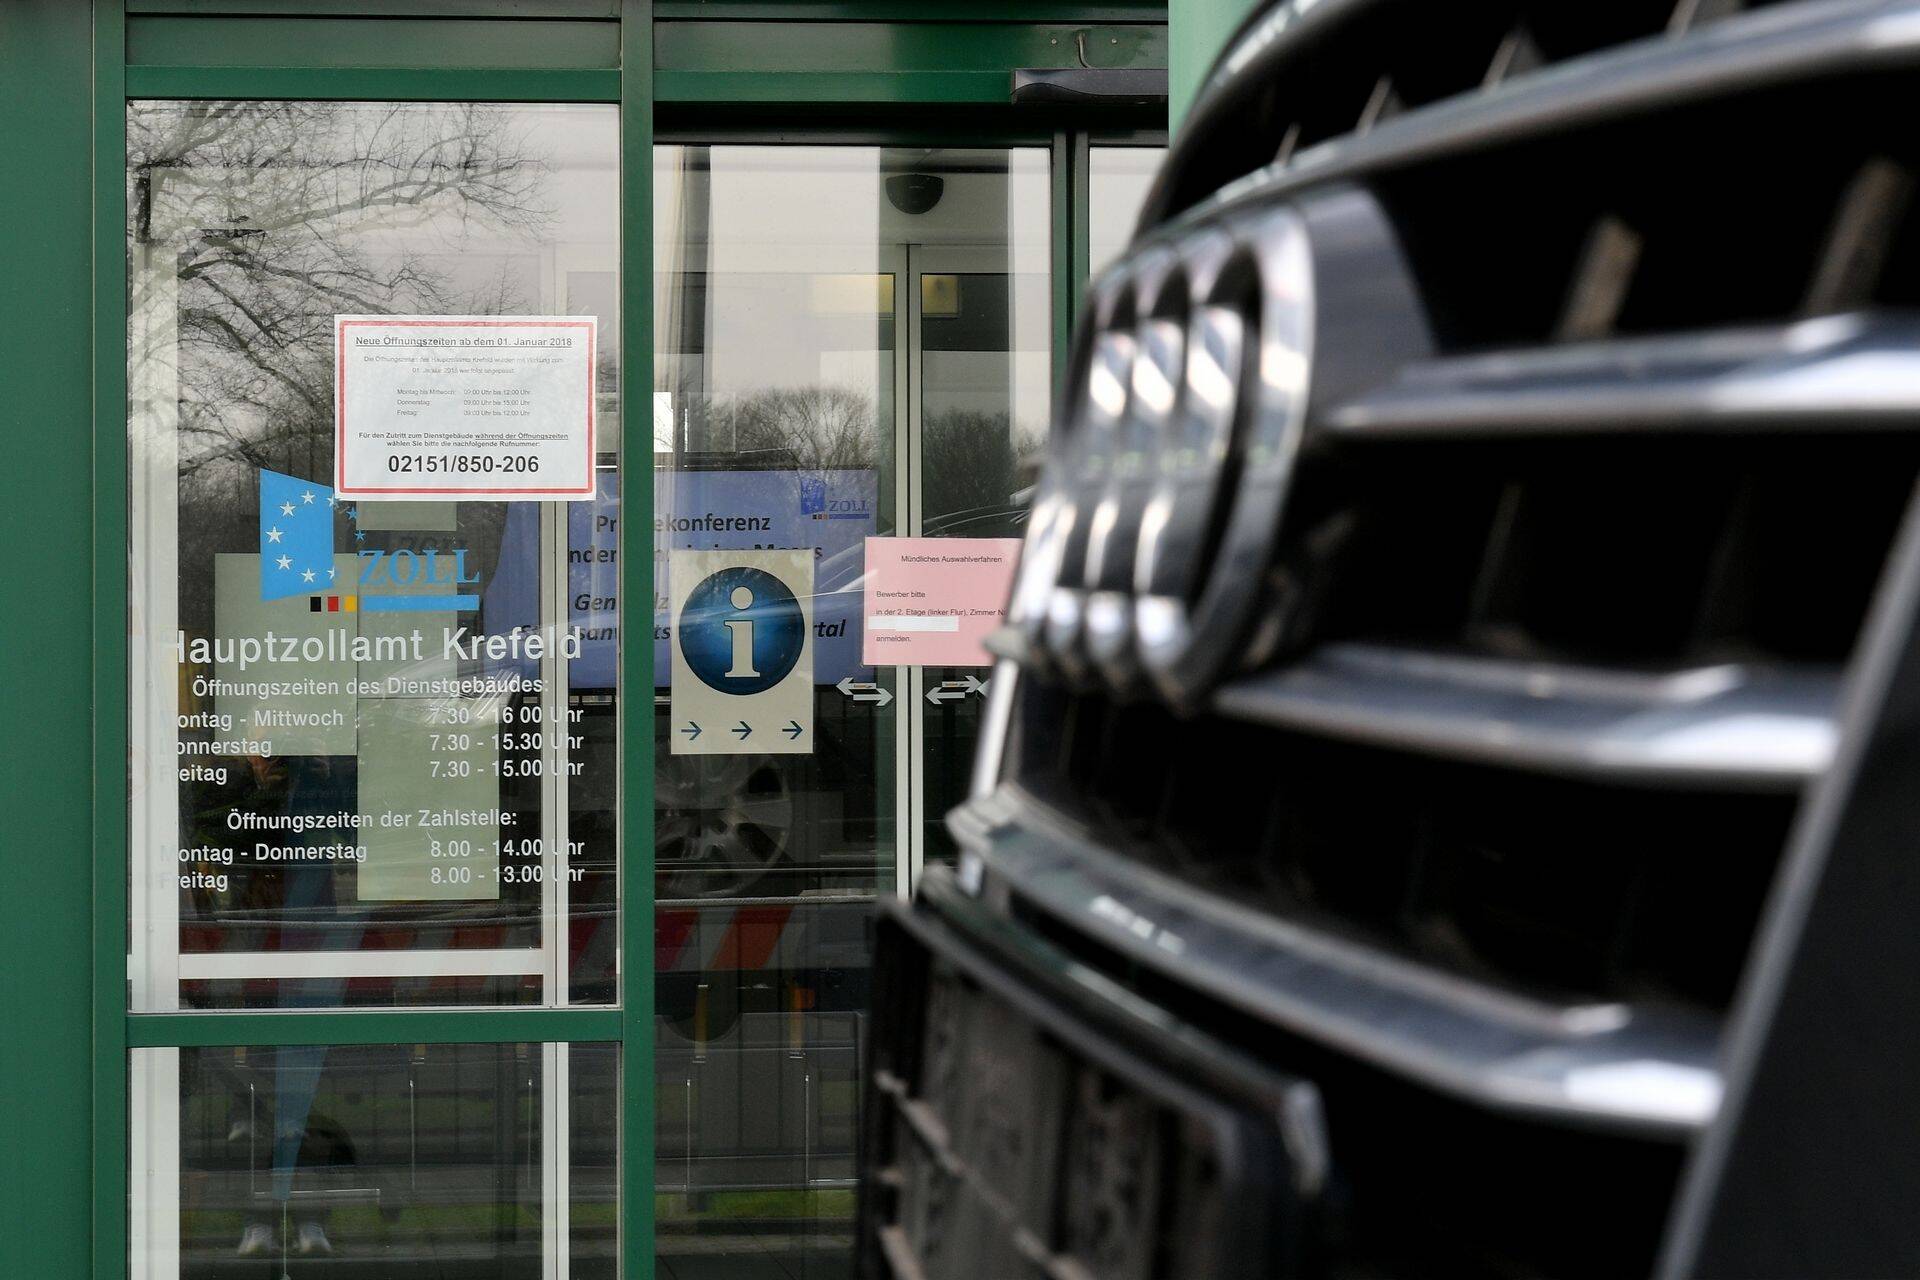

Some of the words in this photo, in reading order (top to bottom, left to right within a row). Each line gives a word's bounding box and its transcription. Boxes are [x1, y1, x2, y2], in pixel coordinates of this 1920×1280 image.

[356, 336, 380, 347] Neue
[383, 335, 456, 347] Öffnungszeiten
[460, 338, 471, 346] ab
[474, 338, 494, 346] dem
[498, 338, 511, 346] 01.
[514, 338, 547, 346] Januar
[550, 338, 572, 347] 2018
[424, 432, 473, 440] Dienstgebäude
[518, 432, 568, 440] Öffnungszeiten
[453, 440, 497, 448] nachfolgende
[388, 455, 539, 473] 02151/850-206
[597, 513, 771, 533] Prekonferenz
[358, 548, 480, 585] ZOLL
[901, 555, 940, 563] Mündliches
[942, 555, 1002, 563] Auswahlverfahren
[876, 591, 909, 599] Bewerber
[906, 609, 926, 617] Etage
[928, 609, 949, 617] (linker
[443, 626, 581, 661] Krefeld
[192, 675, 339, 699] Öffnungszeiten
[346, 678, 380, 695] des
[388, 675, 549, 697] Dienstgebäudes:
[178, 711, 232, 731] ontag
[254, 709, 344, 727] Mittwoch
[430, 706, 470, 724] 7.30
[550, 706, 585, 723] Uhr
[178, 738, 272, 757] onnerstag
[430, 734, 470, 751] 7.30
[492, 733, 542, 750] 15.30
[550, 733, 585, 749] Uhr
[178, 764, 228, 785] eitag
[430, 761, 470, 778] 7.30
[492, 760, 542, 777] 15.00
[550, 760, 585, 776] Uhr
[227, 808, 373, 833] Öffnungszeiten
[380, 811, 412, 827] der
[418, 809, 517, 827] Zahlstelle:
[178, 845, 233, 865] ontag
[255, 843, 367, 863] Donnerstag
[431, 840, 471, 857] 8.00
[492, 839, 543, 856] 14.00
[178, 871, 228, 892] eitag
[431, 867, 471, 884] 8.00
[493, 866, 543, 883] 13.00
